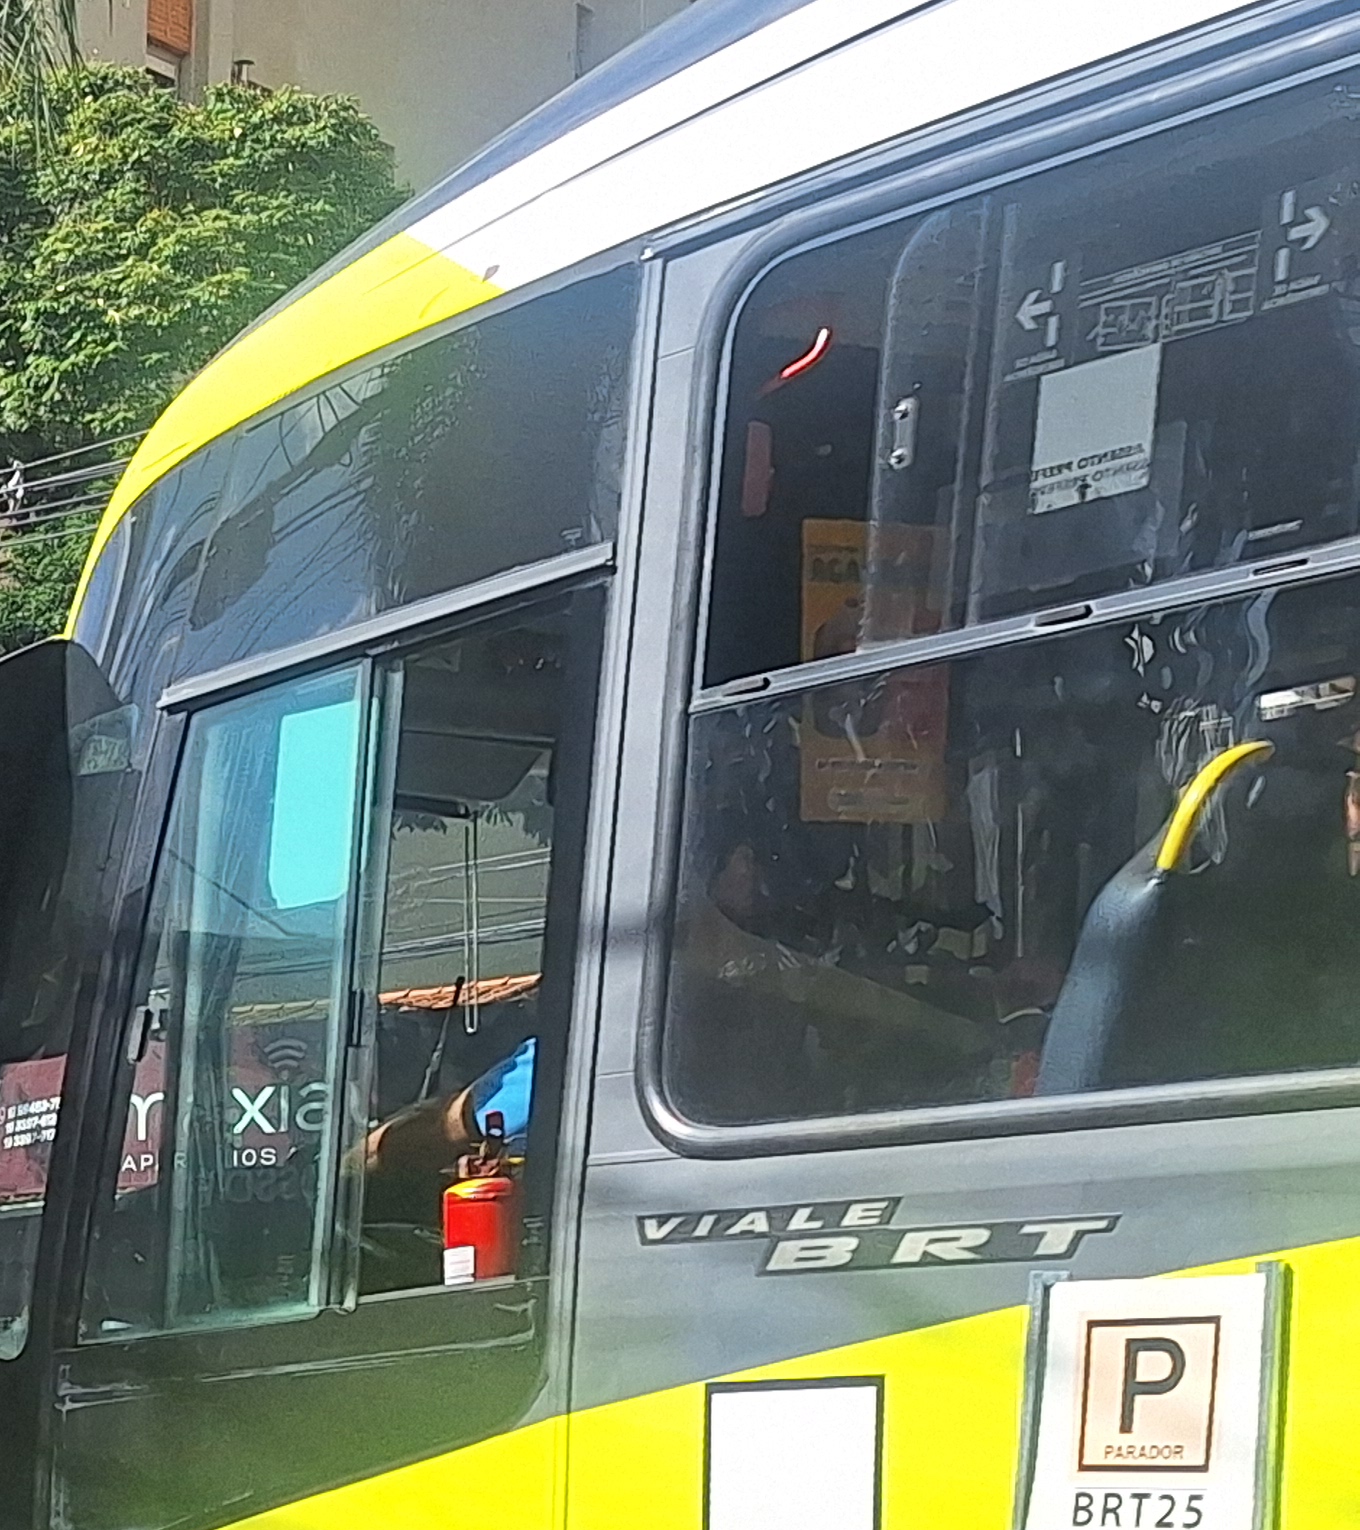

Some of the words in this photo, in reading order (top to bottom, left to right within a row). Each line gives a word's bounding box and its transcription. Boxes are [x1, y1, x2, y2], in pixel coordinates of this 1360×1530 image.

[643, 1200, 889, 1241] VIALE
[765, 1219, 1108, 1271] BRT
[1119, 1337, 1186, 1434] P
[1104, 1445, 1185, 1460] PARADOR
[1072, 1491, 1204, 1529] BRT25
